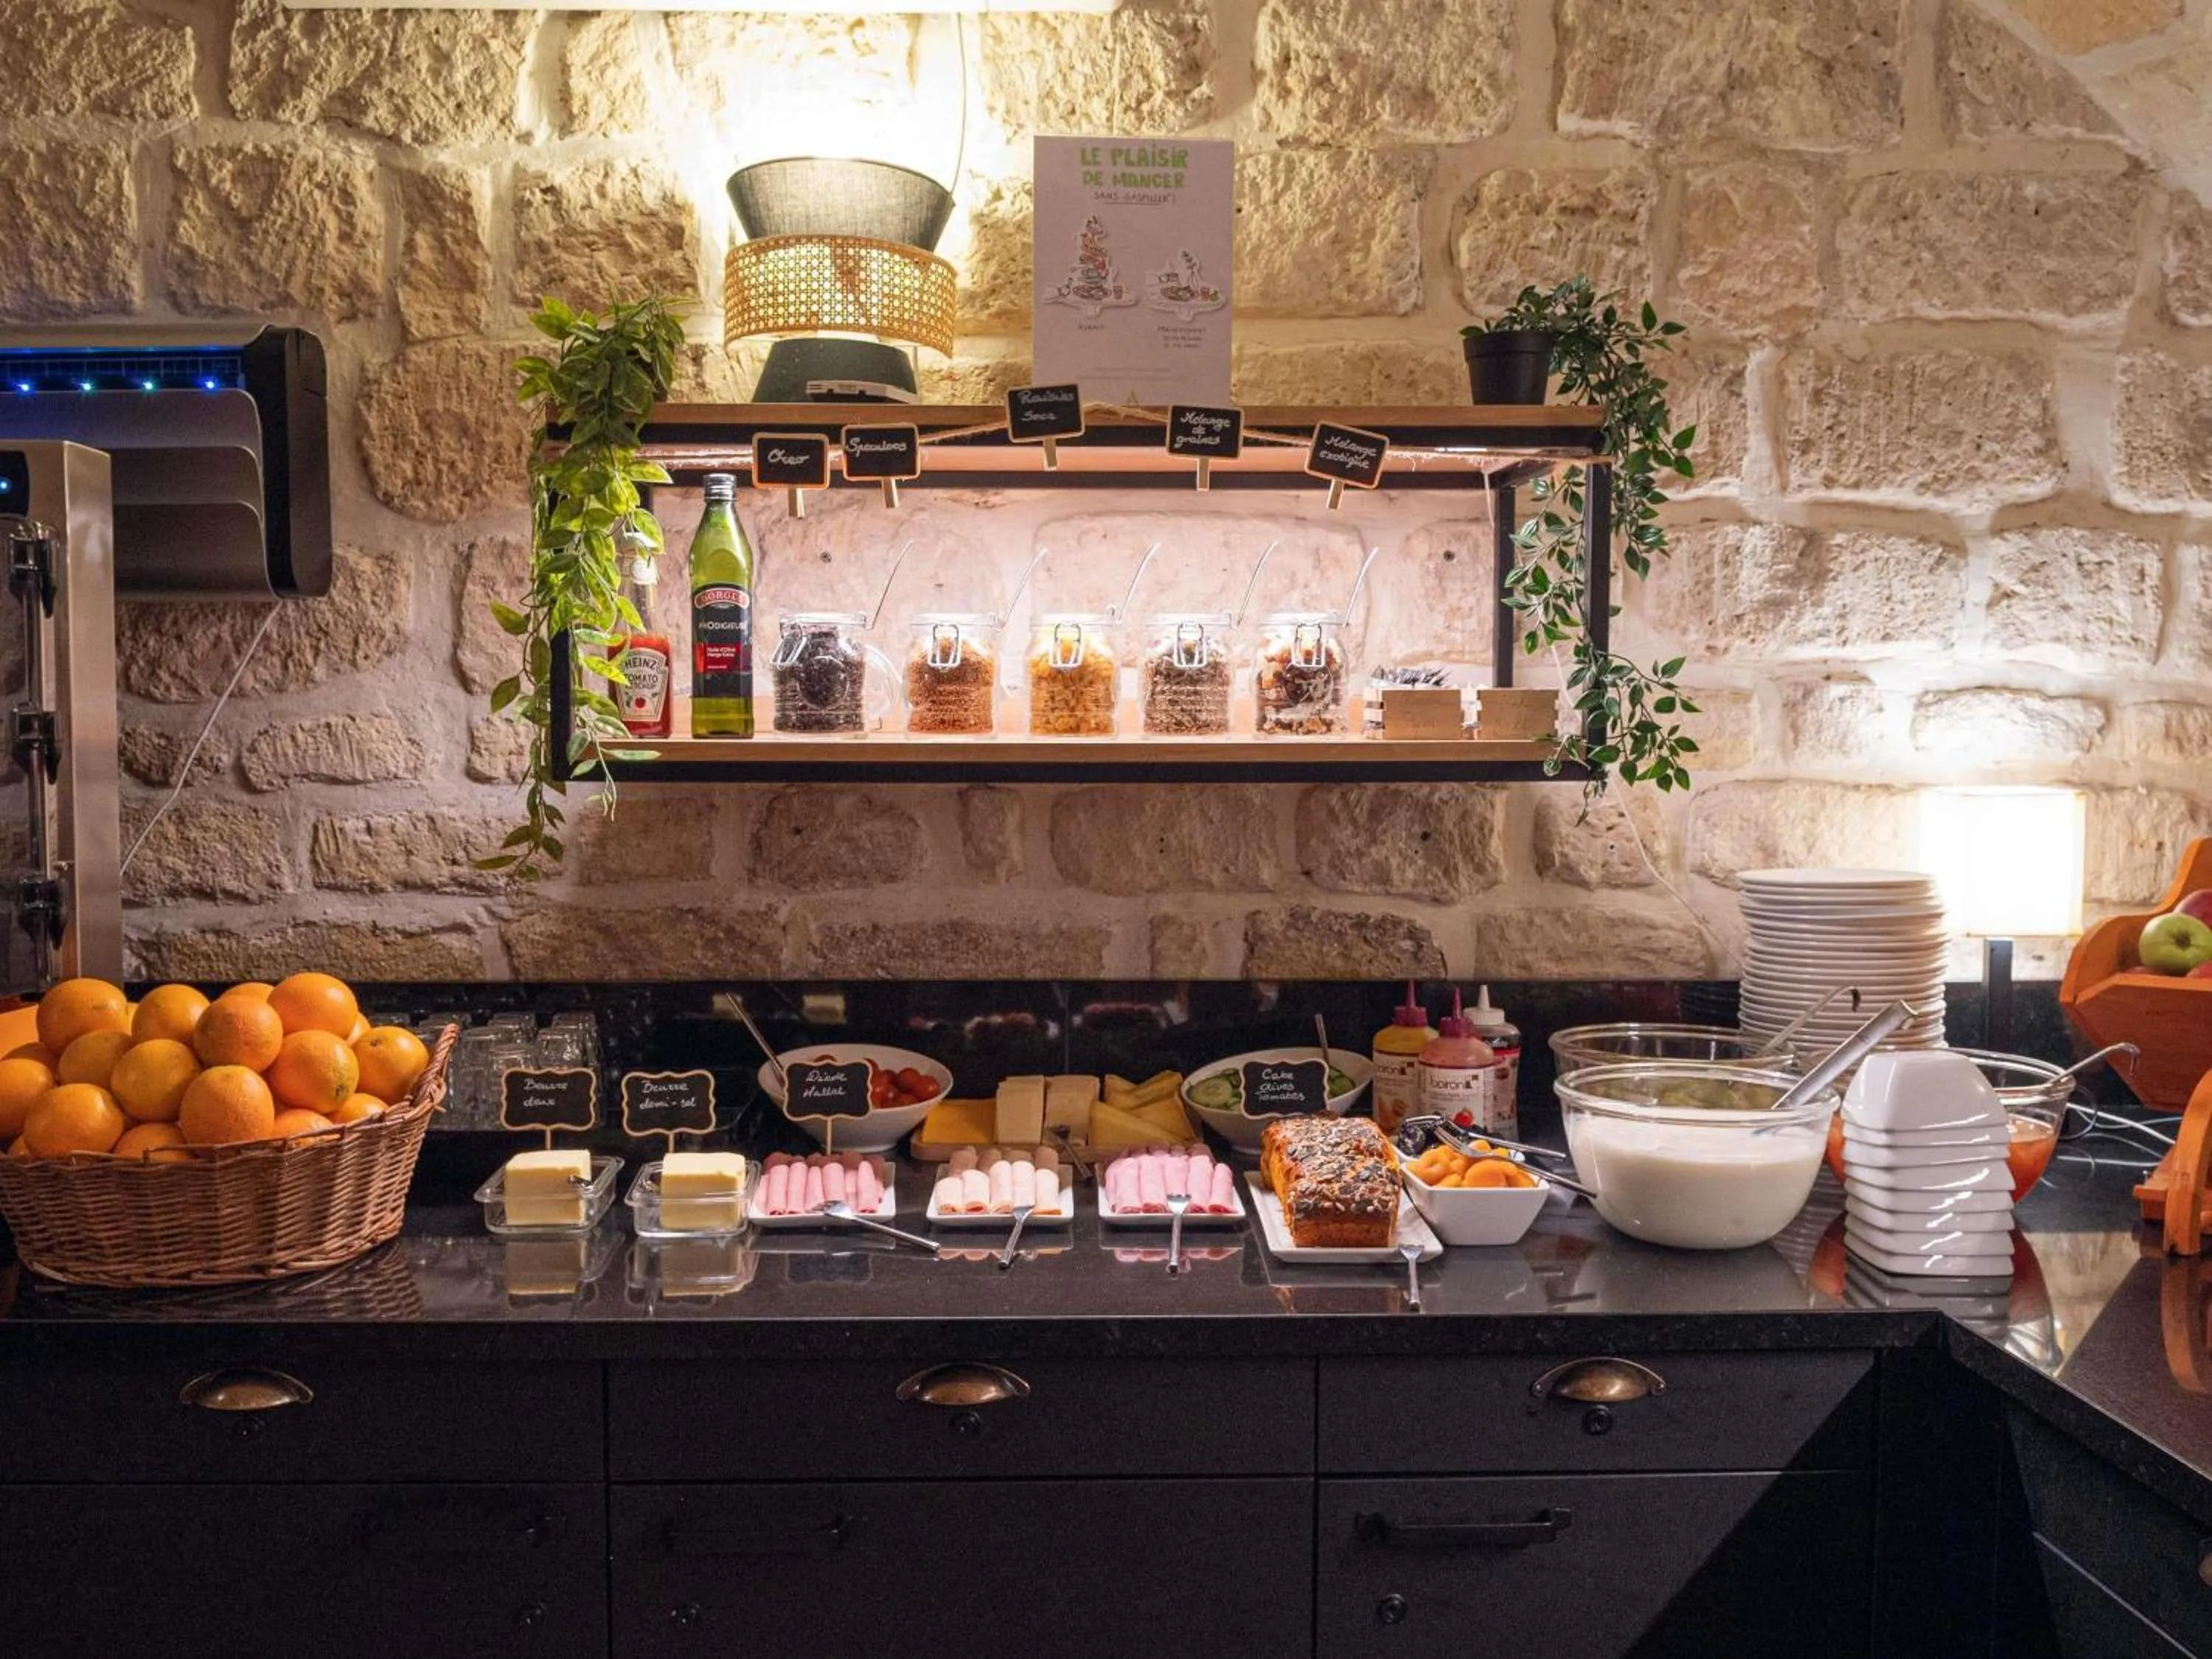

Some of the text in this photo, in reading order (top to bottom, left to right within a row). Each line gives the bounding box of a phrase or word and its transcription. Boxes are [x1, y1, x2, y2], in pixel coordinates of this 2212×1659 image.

[1079, 147, 1102, 167] LE
[1082, 170, 1104, 185] DE
[625, 657, 657, 670] HEINZ
